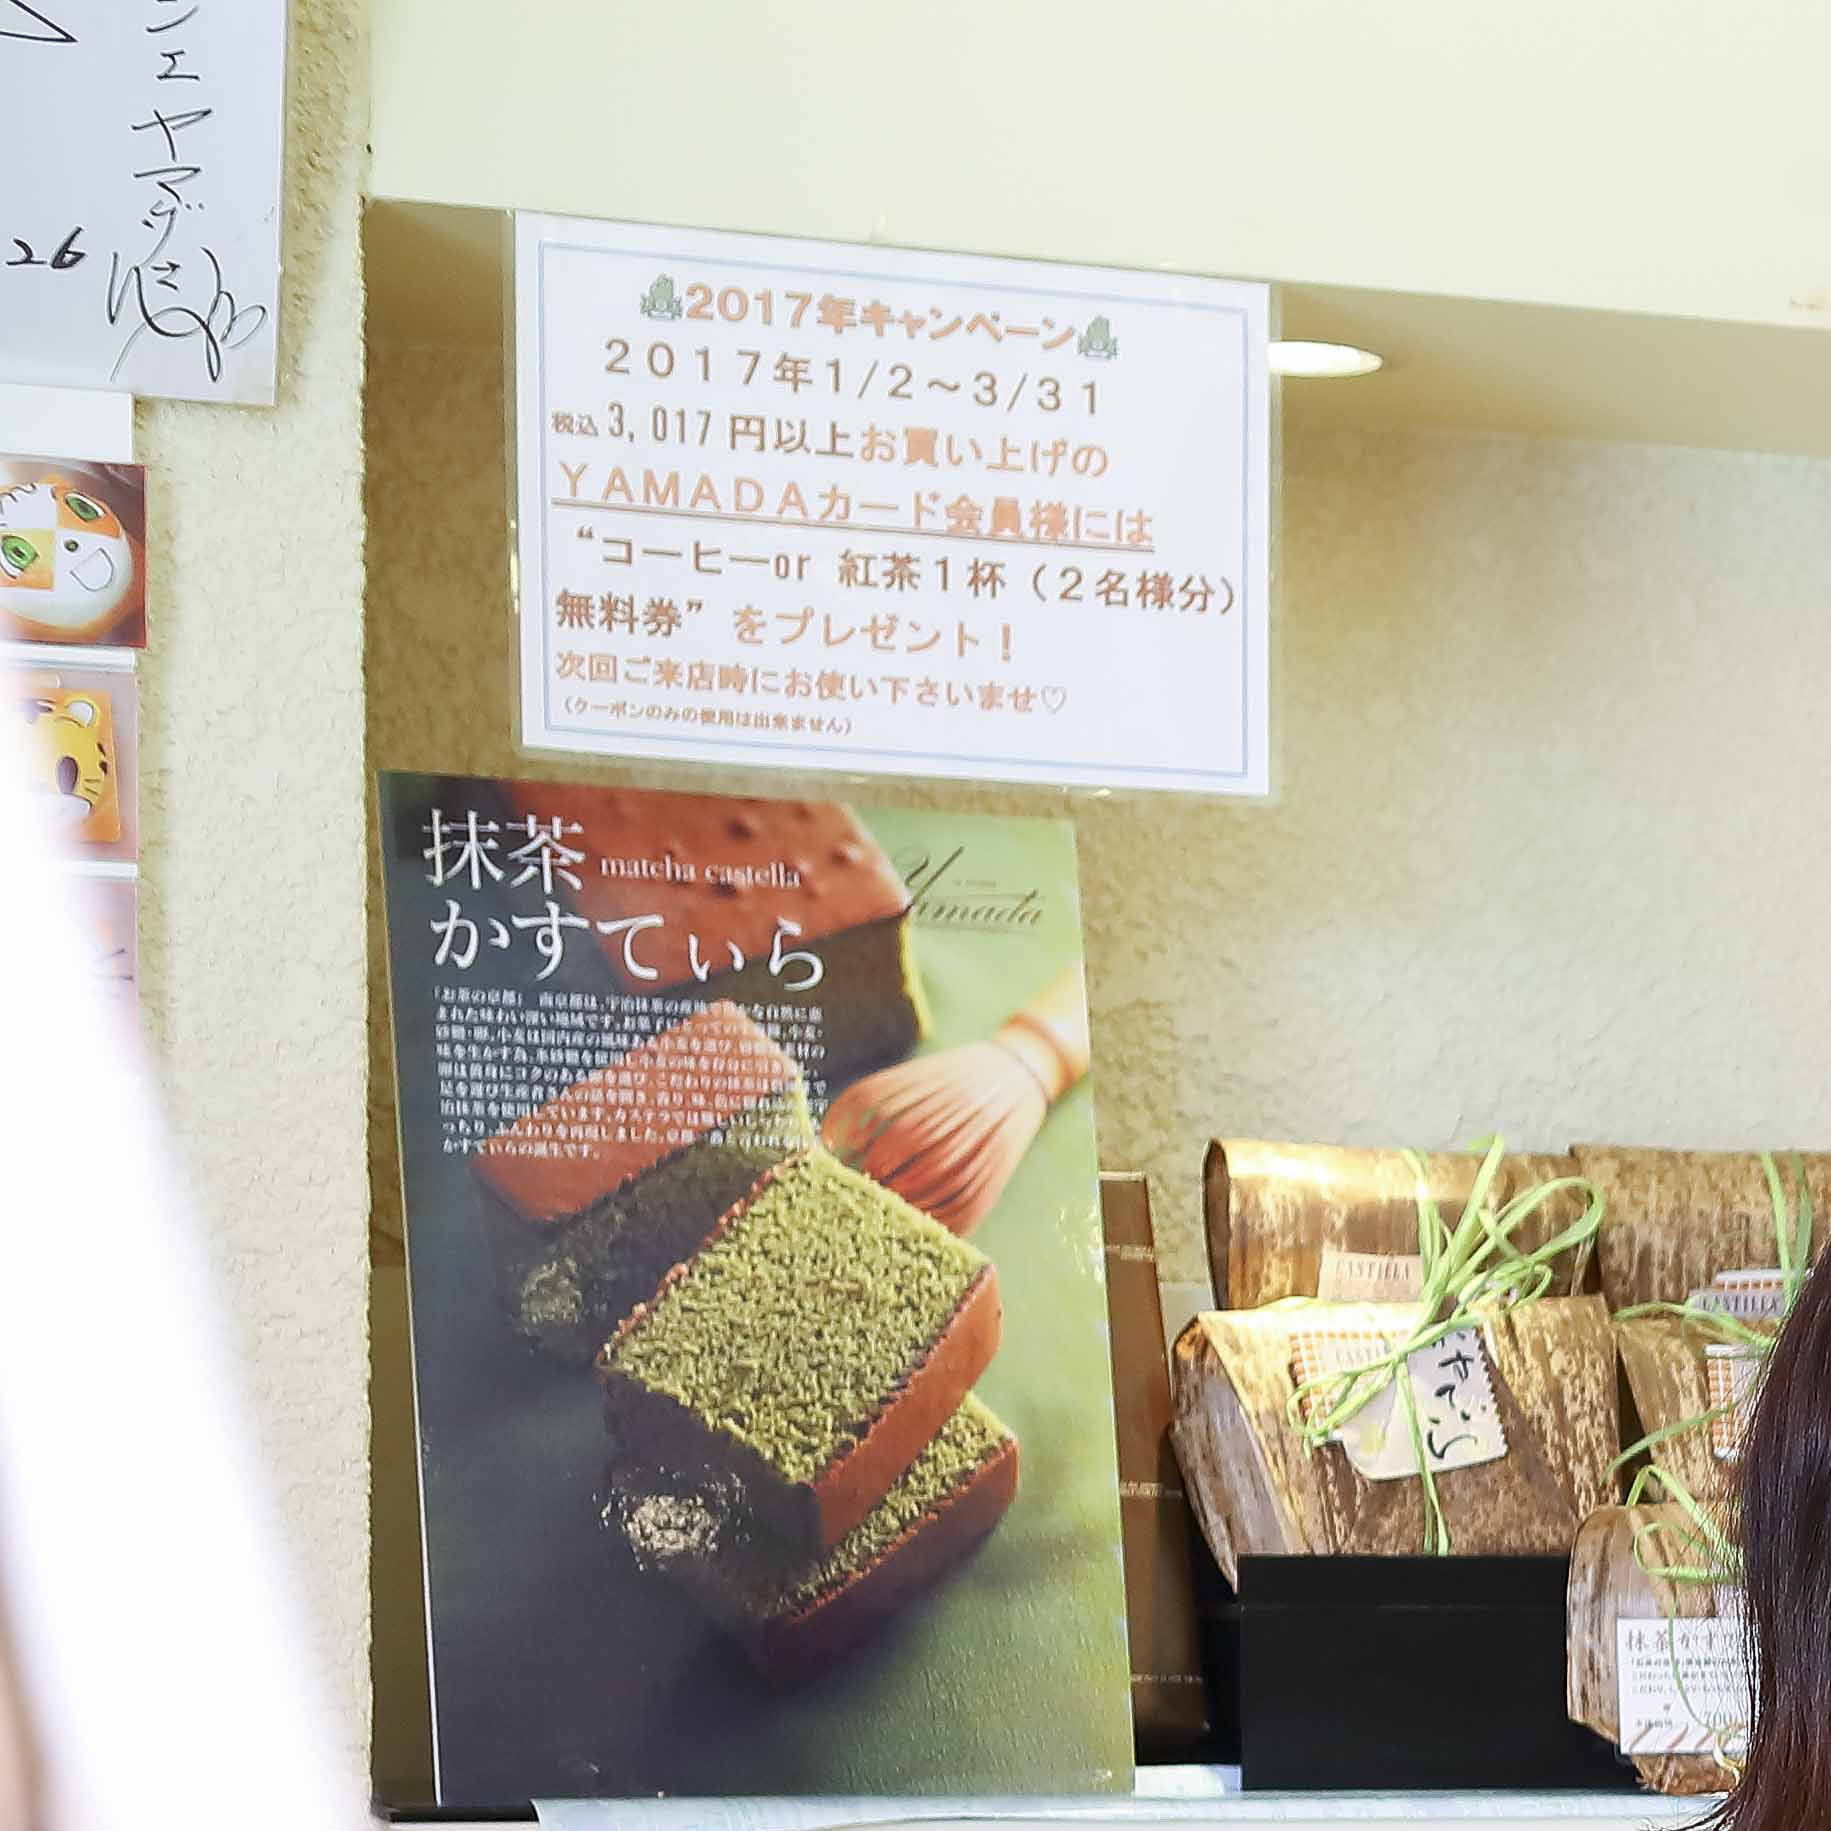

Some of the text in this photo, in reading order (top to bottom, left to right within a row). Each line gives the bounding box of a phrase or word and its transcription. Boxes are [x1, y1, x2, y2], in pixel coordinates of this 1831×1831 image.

[684, 282, 1076, 352] 2017年キャンペーン
[557, 461, 1155, 545] YAMADAカード会員様には
[422, 808, 801, 895] 抹茶 matcha castella
